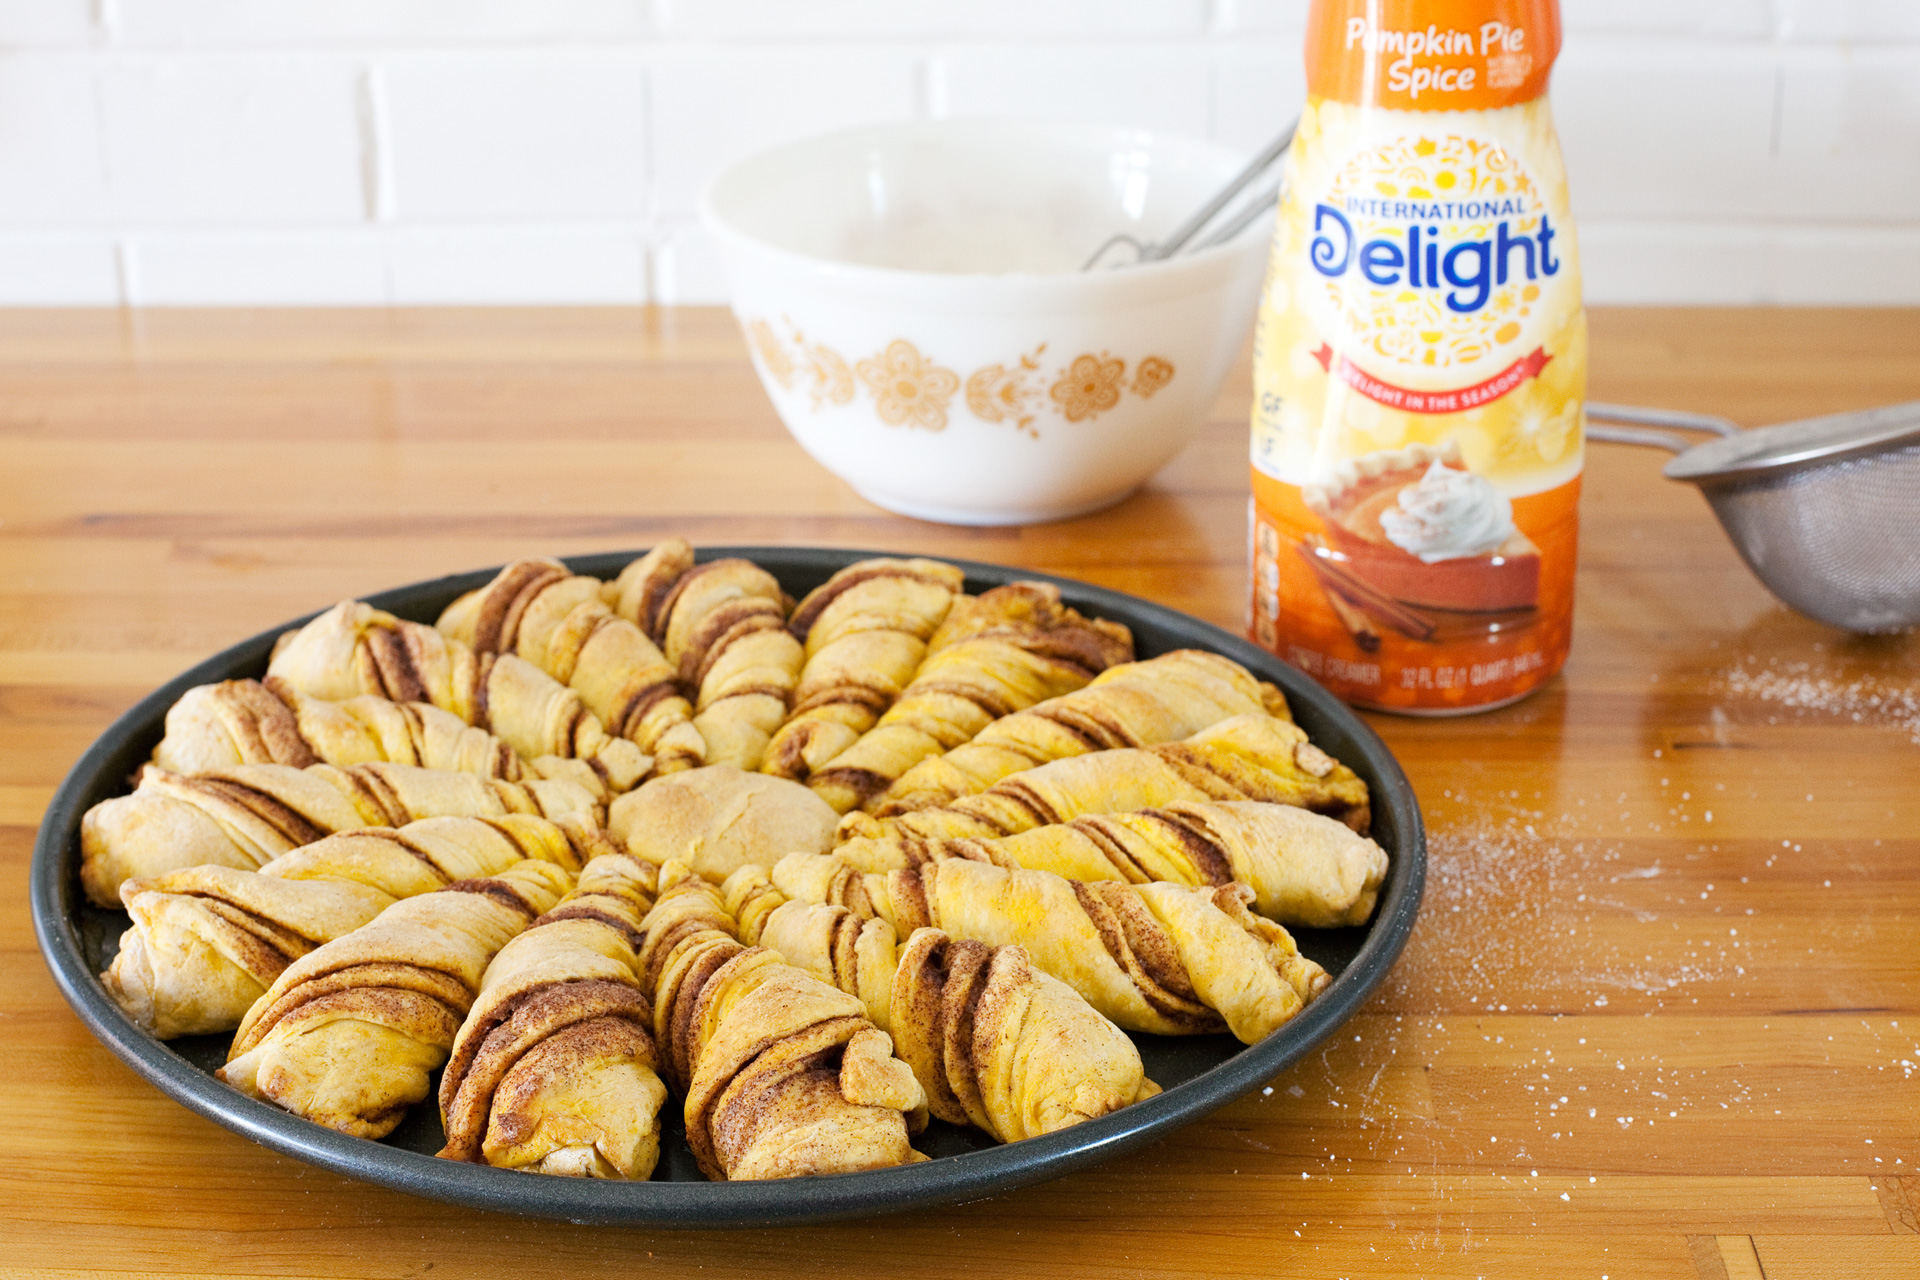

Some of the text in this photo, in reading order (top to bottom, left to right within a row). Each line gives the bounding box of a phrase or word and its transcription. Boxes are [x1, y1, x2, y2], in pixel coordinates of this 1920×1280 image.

[1480, 21, 1524, 56] Pie
[1387, 58, 1477, 100] Spice
[1346, 197, 1526, 220] INTERNATIONAL
[1310, 215, 1560, 313] Delight
[1405, 394, 1424, 410] IN
[1428, 395, 1457, 410] THE
